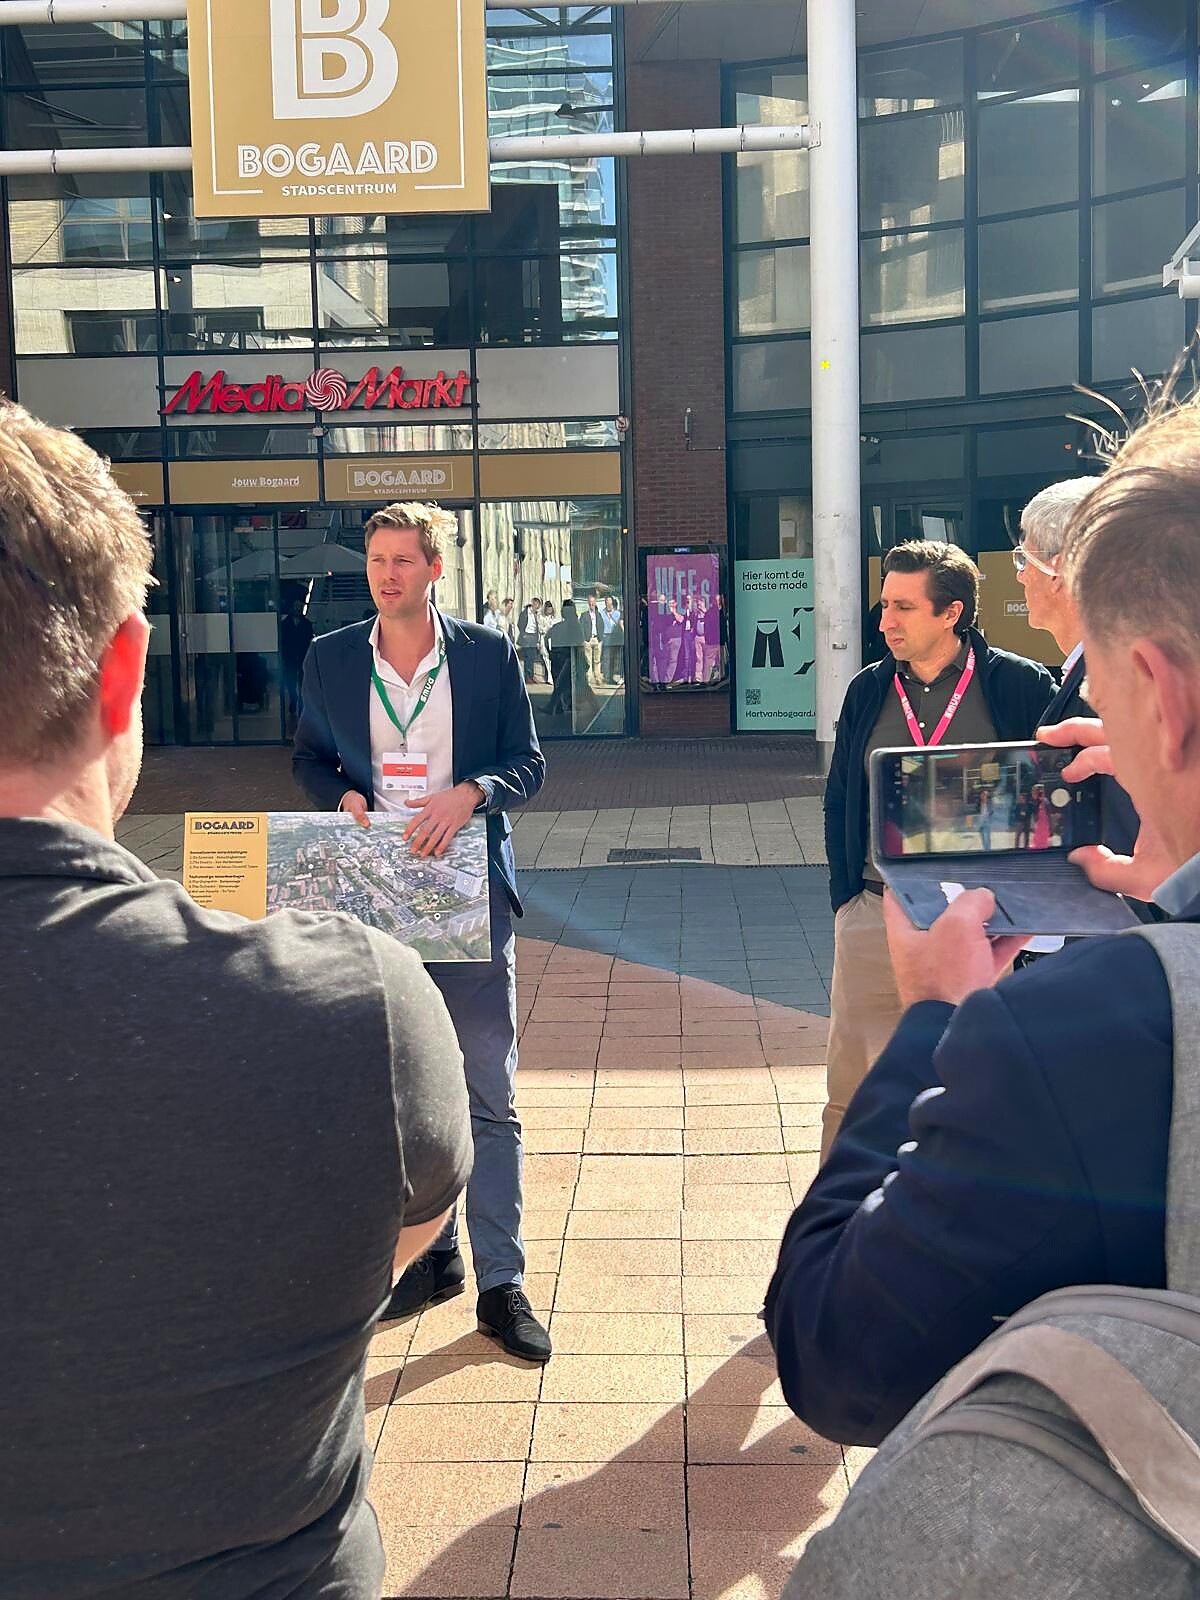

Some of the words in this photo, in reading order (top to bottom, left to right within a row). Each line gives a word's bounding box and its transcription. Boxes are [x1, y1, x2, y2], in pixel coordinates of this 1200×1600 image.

[270, 0, 399, 120] B
[237, 140, 438, 178] BOGAARD
[281, 182, 397, 197] STADSCENTRUM
[231, 477, 257, 488] Jouw
[259, 475, 300, 489] Bogaard
[354, 469, 447, 486] BOGAARD
[742, 571, 762, 580] Hier
[764, 570, 790, 580] komt
[791, 569, 805, 579] de
[742, 581, 776, 591] laatste
[779, 580, 808, 590] mode
[194, 821, 255, 831] BOGAARD
